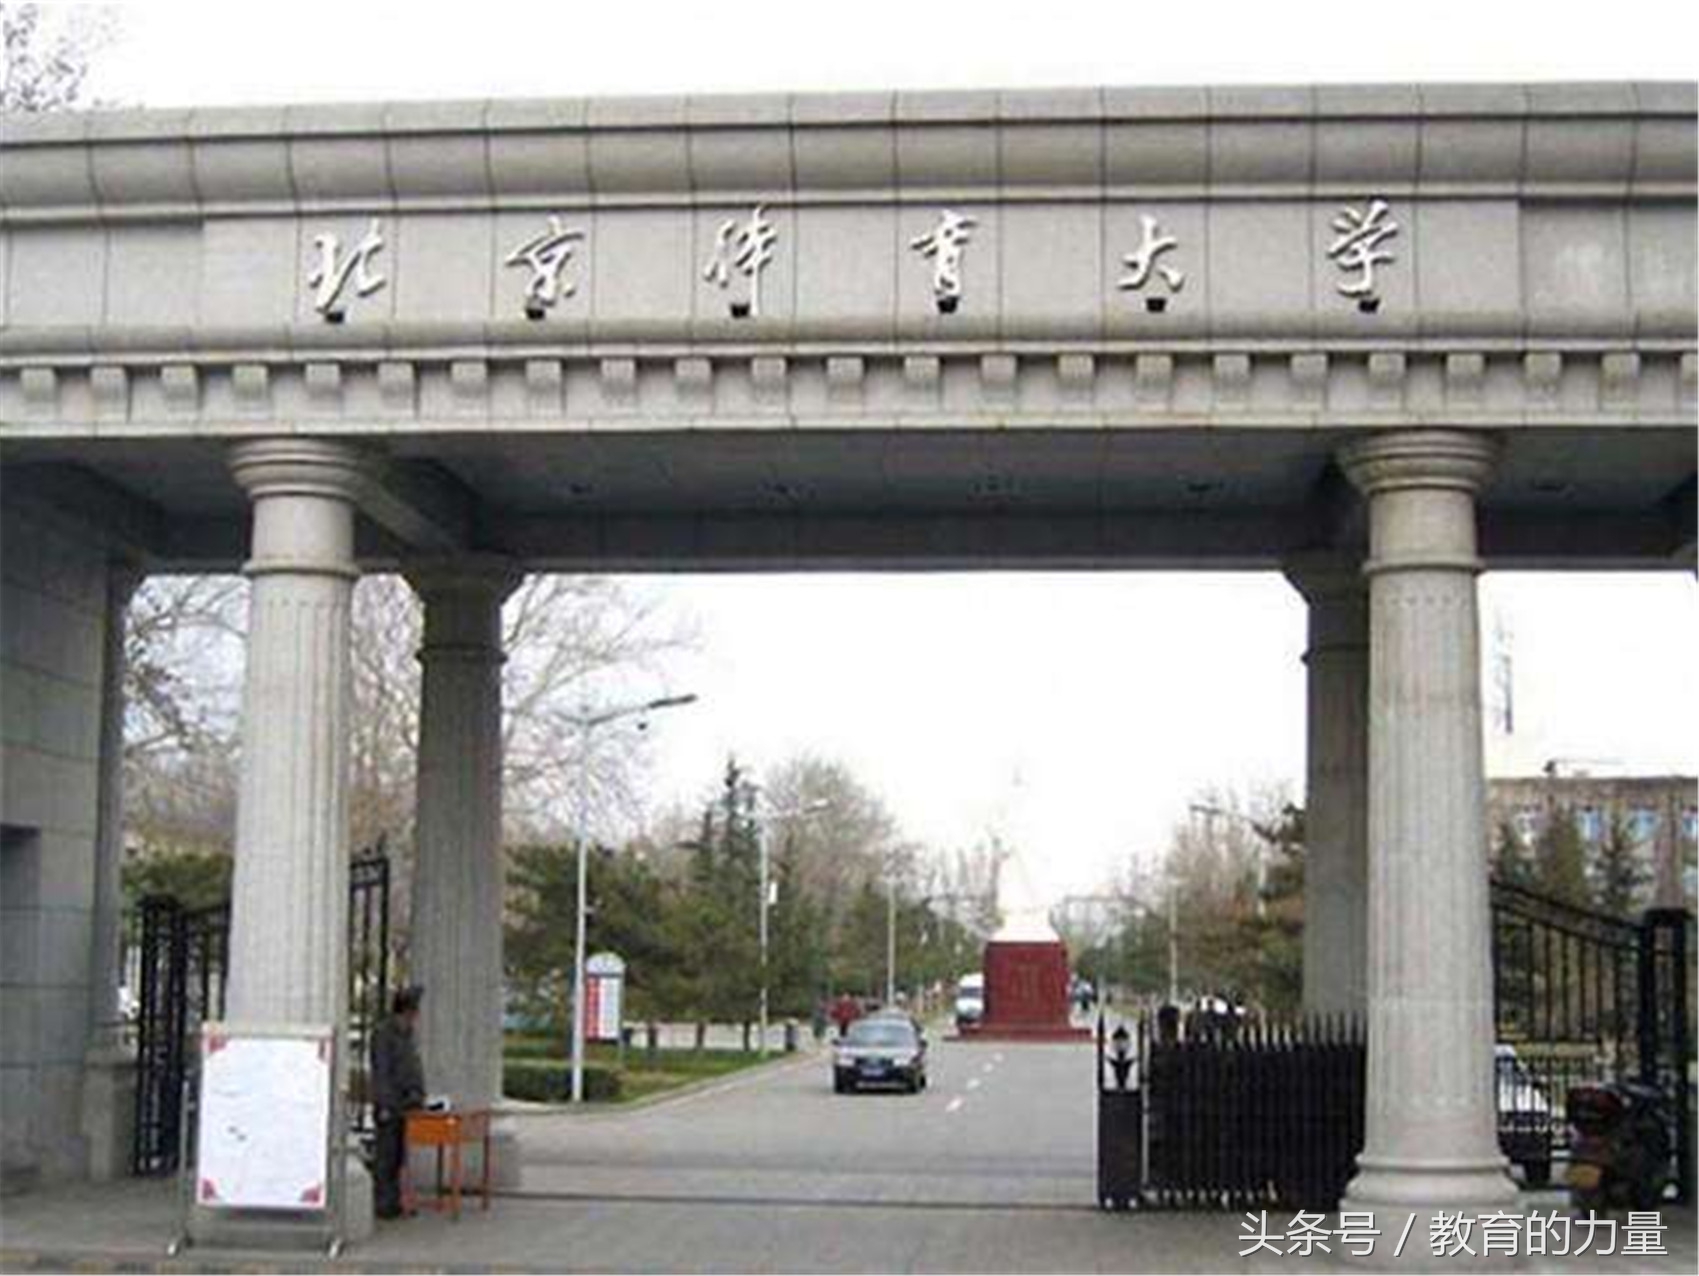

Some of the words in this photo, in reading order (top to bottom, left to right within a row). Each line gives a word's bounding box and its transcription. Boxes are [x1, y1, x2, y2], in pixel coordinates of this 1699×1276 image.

[308, 200, 1400, 316] 北京体育大学
